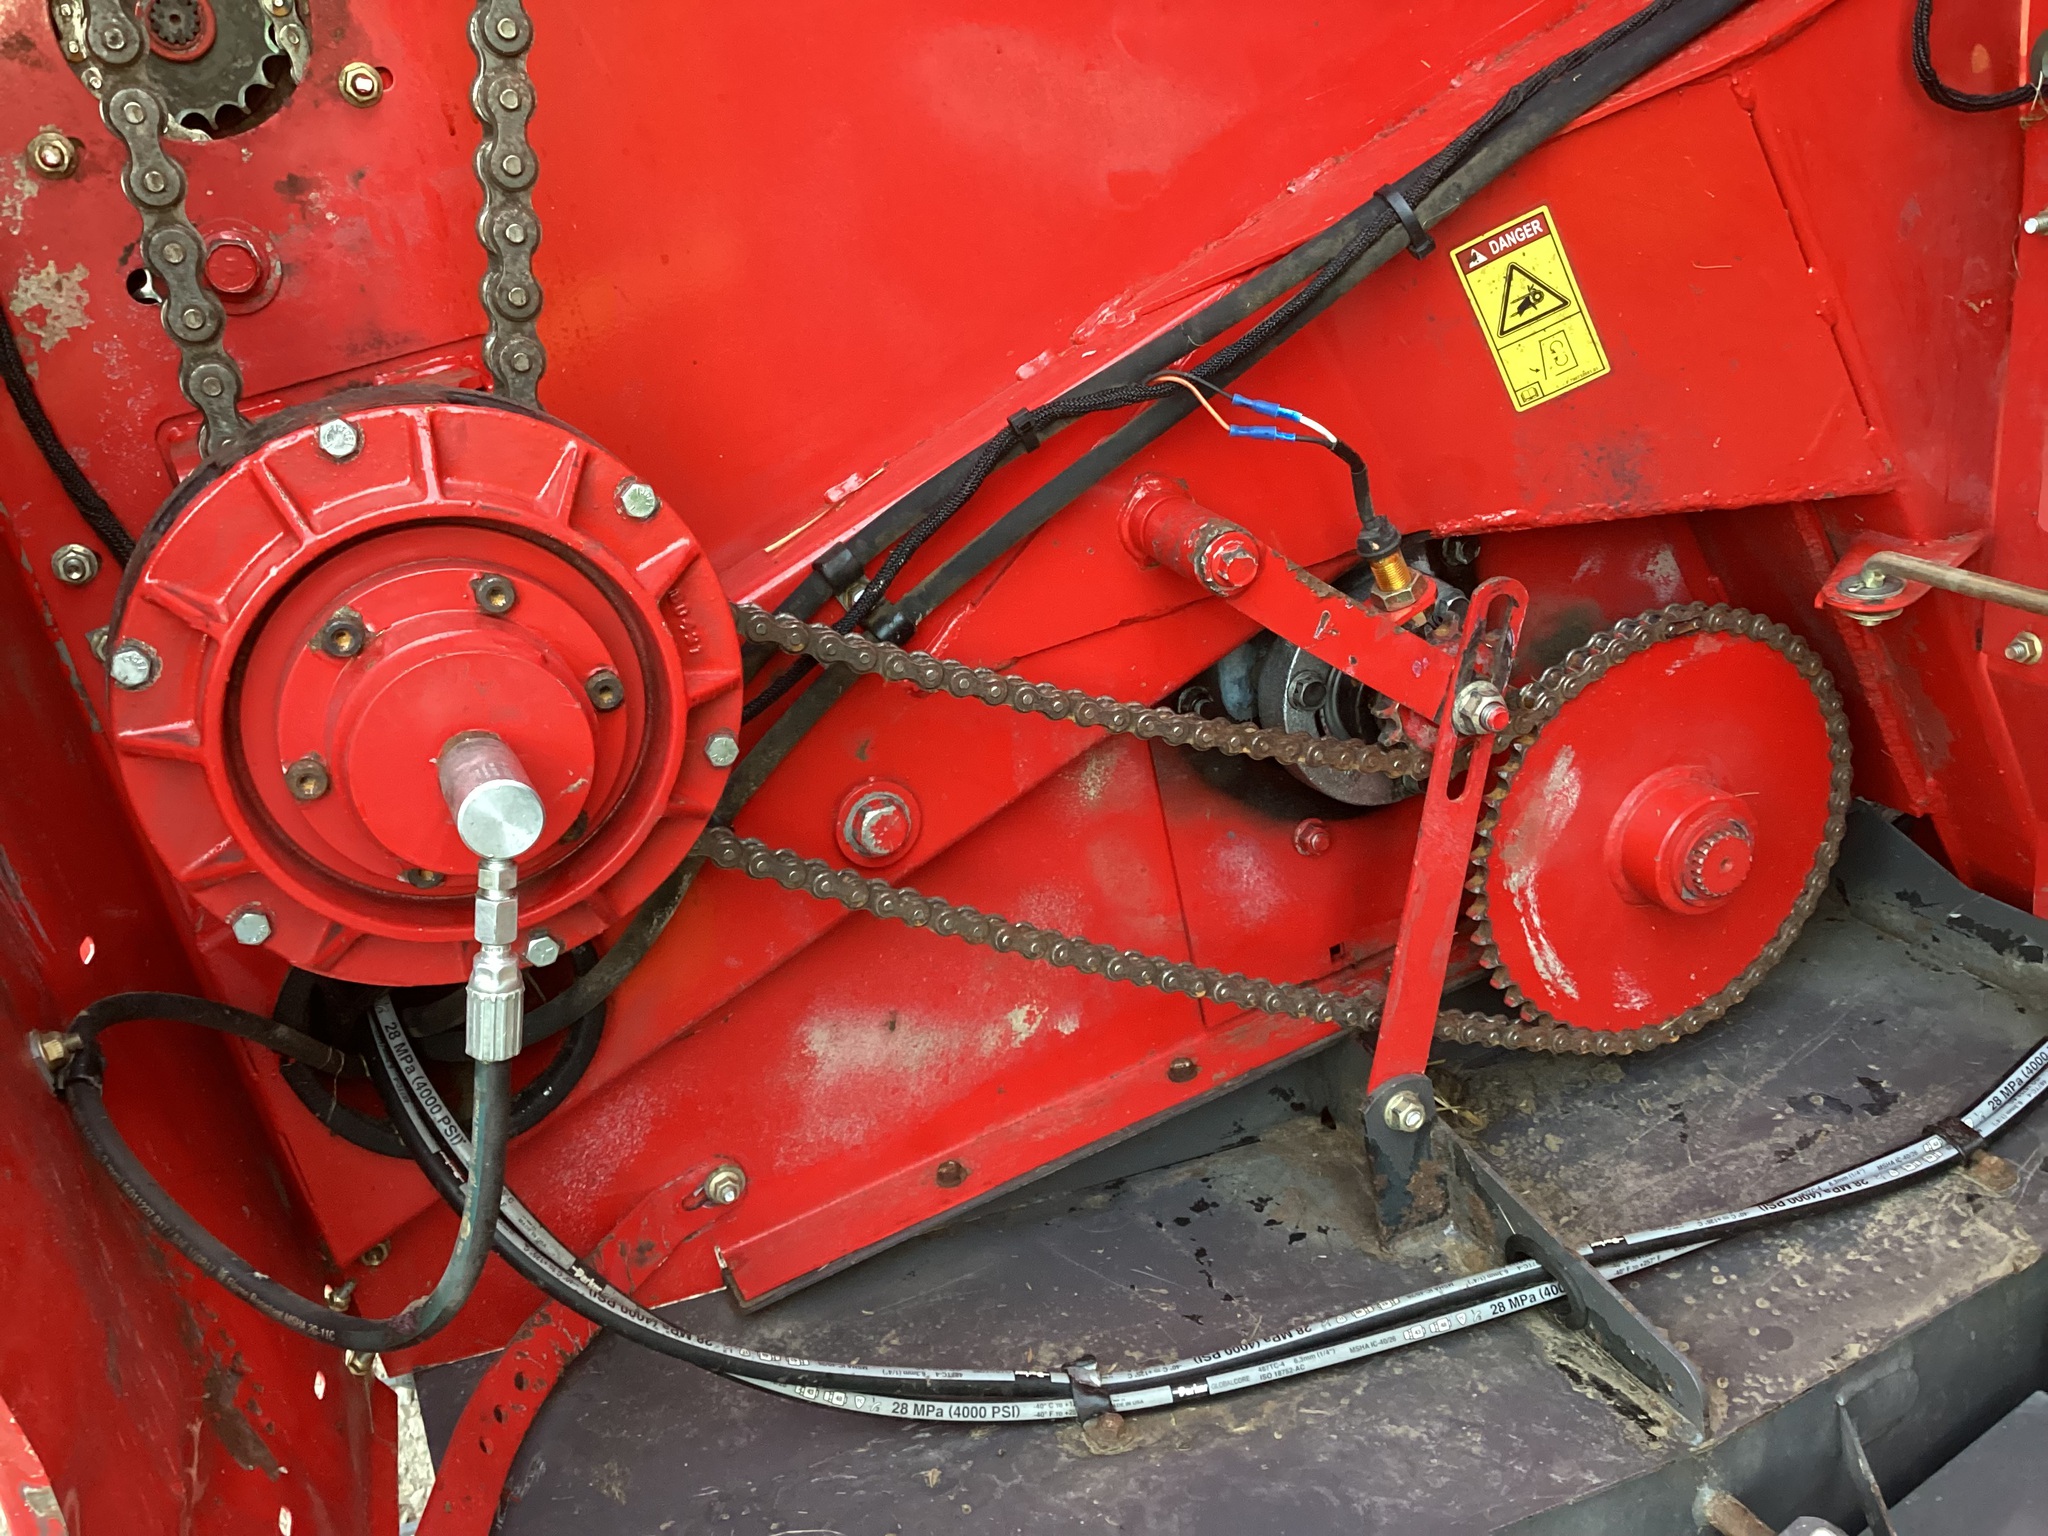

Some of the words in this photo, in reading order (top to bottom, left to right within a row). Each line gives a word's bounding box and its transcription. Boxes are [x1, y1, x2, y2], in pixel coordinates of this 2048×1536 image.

[1488, 219, 1543, 255] DANGER
[382, 1020, 402, 1041] 28
[390, 1040, 420, 1075] MPa
[1985, 1093, 2003, 1111] 28
[1998, 1073, 2024, 1100] MPa
[2019, 1048, 2048, 1080] (4000
[409, 1073, 444, 1116] (4000
[1489, 1301, 1506, 1315] 28
[1507, 1290, 1537, 1309] MPa
[1348, 1341, 1370, 1353] MSHA
[1258, 1371, 1273, 1381] ISO
[1174, 1383, 1208, 1397] Parker
[892, 1402, 908, 1415] 28
[912, 1403, 944, 1417] MPa
[950, 1404, 987, 1419] (4000
[992, 1404, 1020, 1419] PSI)
